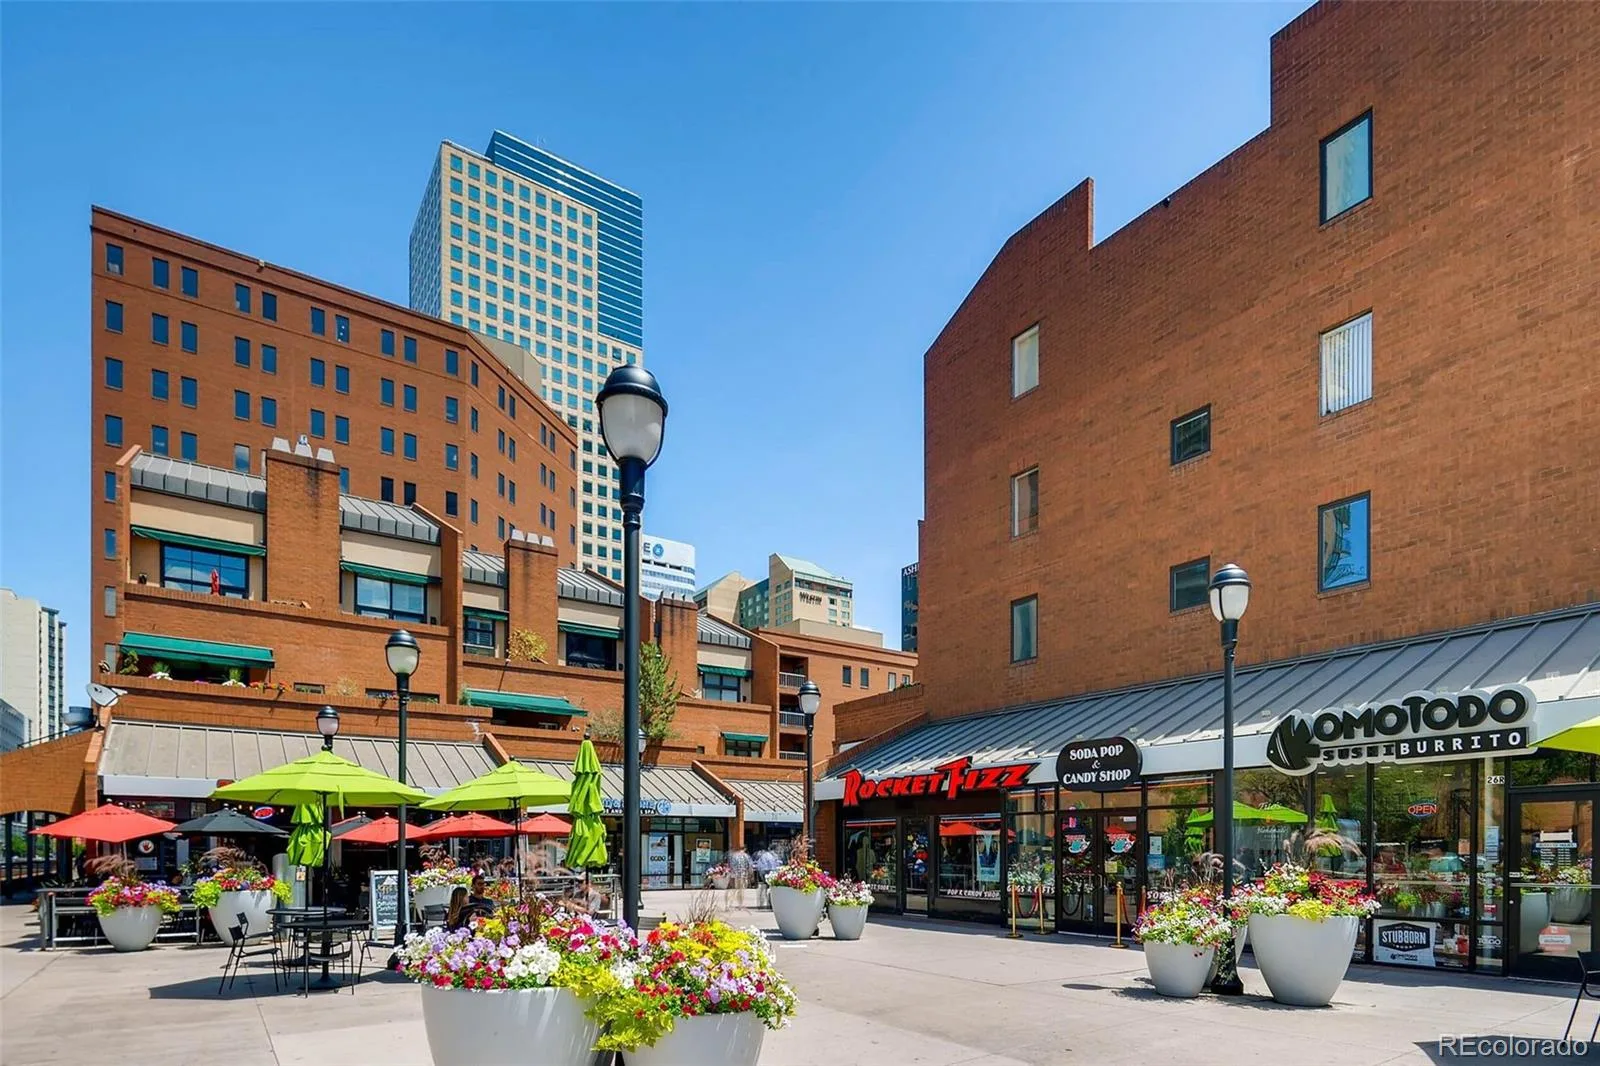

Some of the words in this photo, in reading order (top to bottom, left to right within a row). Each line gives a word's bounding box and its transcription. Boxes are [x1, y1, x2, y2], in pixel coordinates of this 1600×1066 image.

[1069, 748, 1098, 760] SODA
[1100, 745, 1123, 757] POP
[1323, 743, 1394, 760] SUSHI
[1400, 731, 1521, 755] BURRITO
[1092, 760, 1100, 769] &
[838, 769, 944, 807] ROCKET
[934, 756, 1034, 799] FIZZ
[1063, 772, 1098, 784] CANDY
[1099, 769, 1131, 782] SHOP
[1408, 804, 1437, 814] OPEN
[1382, 929, 1426, 944] STUBBORN
